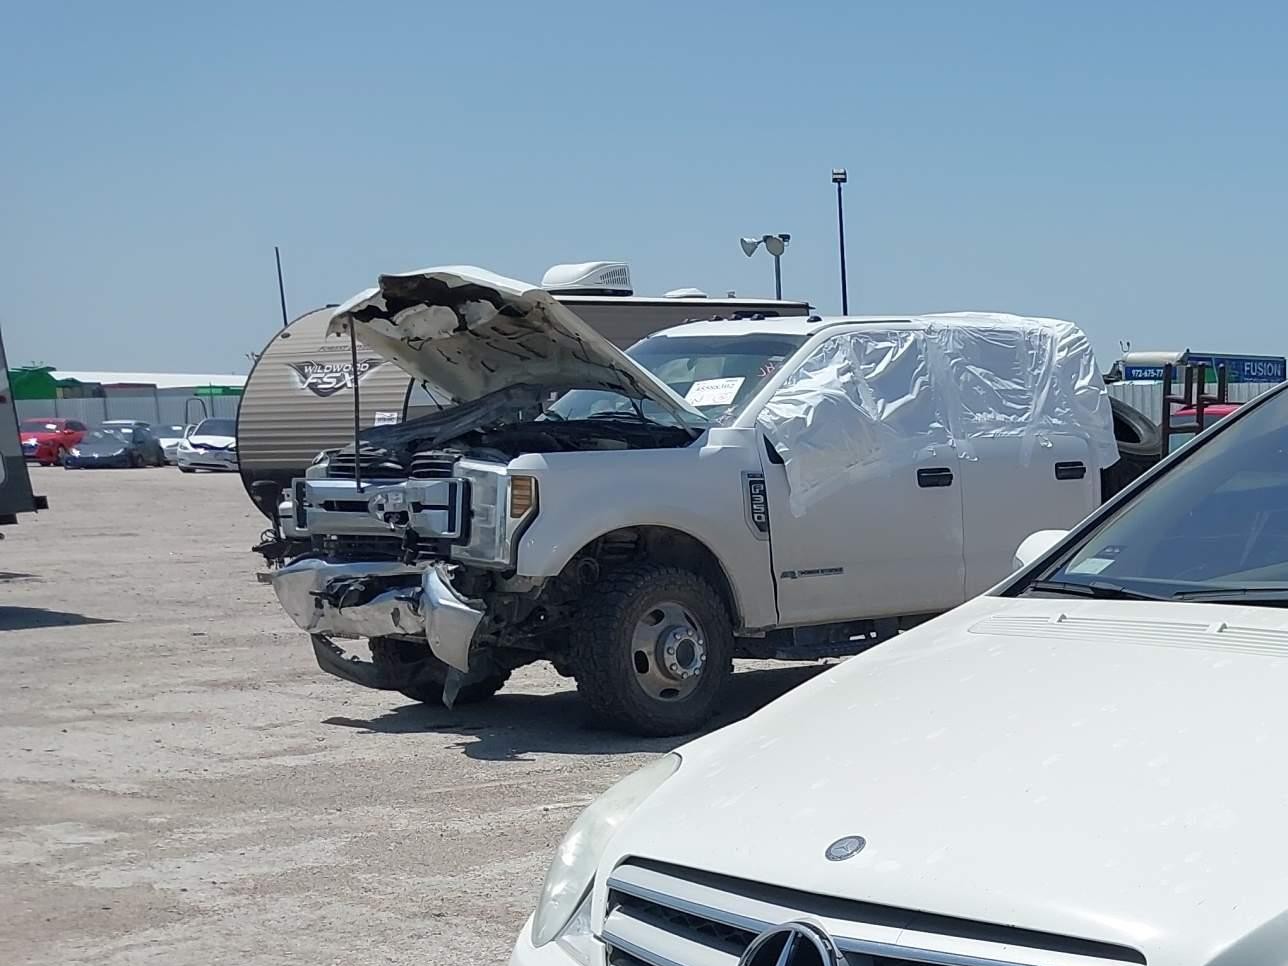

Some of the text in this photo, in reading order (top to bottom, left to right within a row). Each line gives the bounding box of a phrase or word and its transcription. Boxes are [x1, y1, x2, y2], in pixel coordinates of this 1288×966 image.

[1131, 369, 1164, 379] 972-675-77
[1244, 362, 1281, 377] FUSION
[301, 372, 360, 389] FSX
[752, 483, 766, 522] F350
